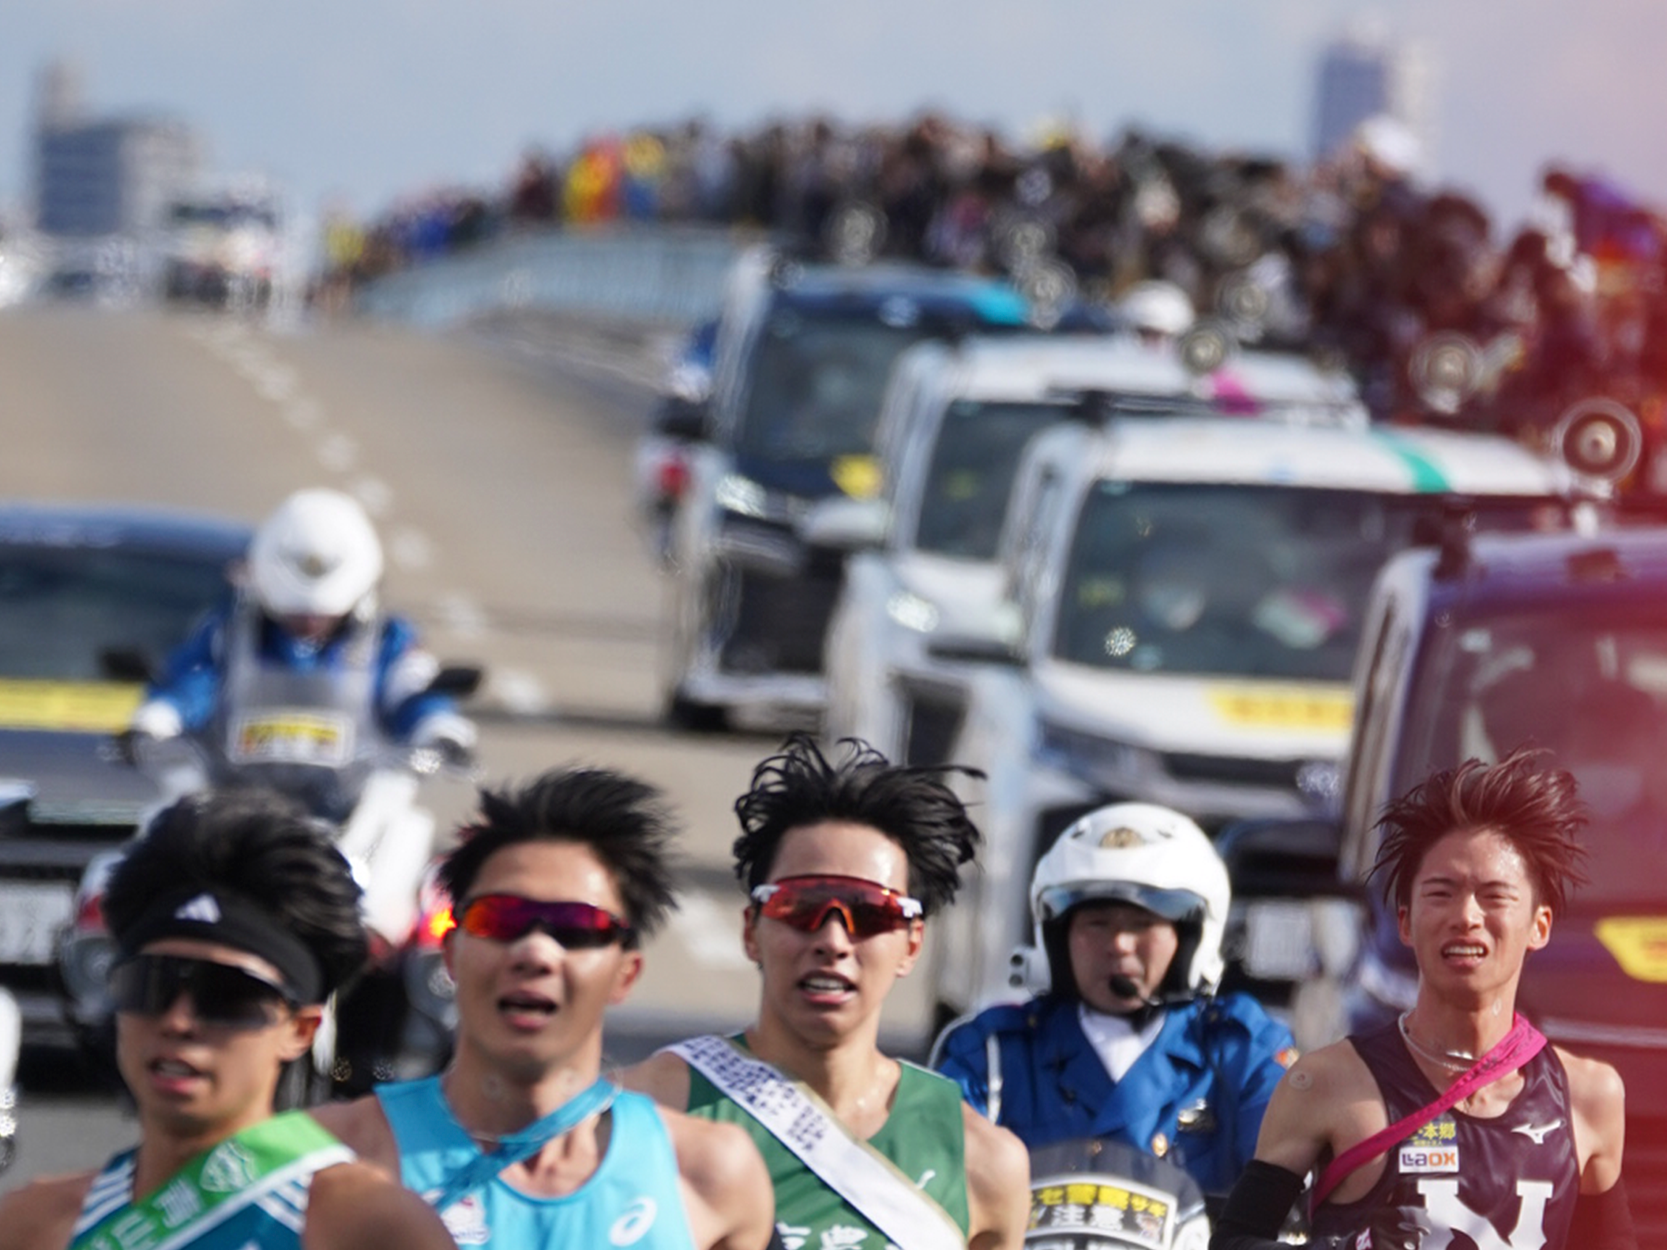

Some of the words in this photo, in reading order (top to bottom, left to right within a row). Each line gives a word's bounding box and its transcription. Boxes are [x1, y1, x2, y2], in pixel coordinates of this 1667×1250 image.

[1032, 1183, 1168, 1219] セ警察サギ
[1051, 1203, 1125, 1231] 注意
